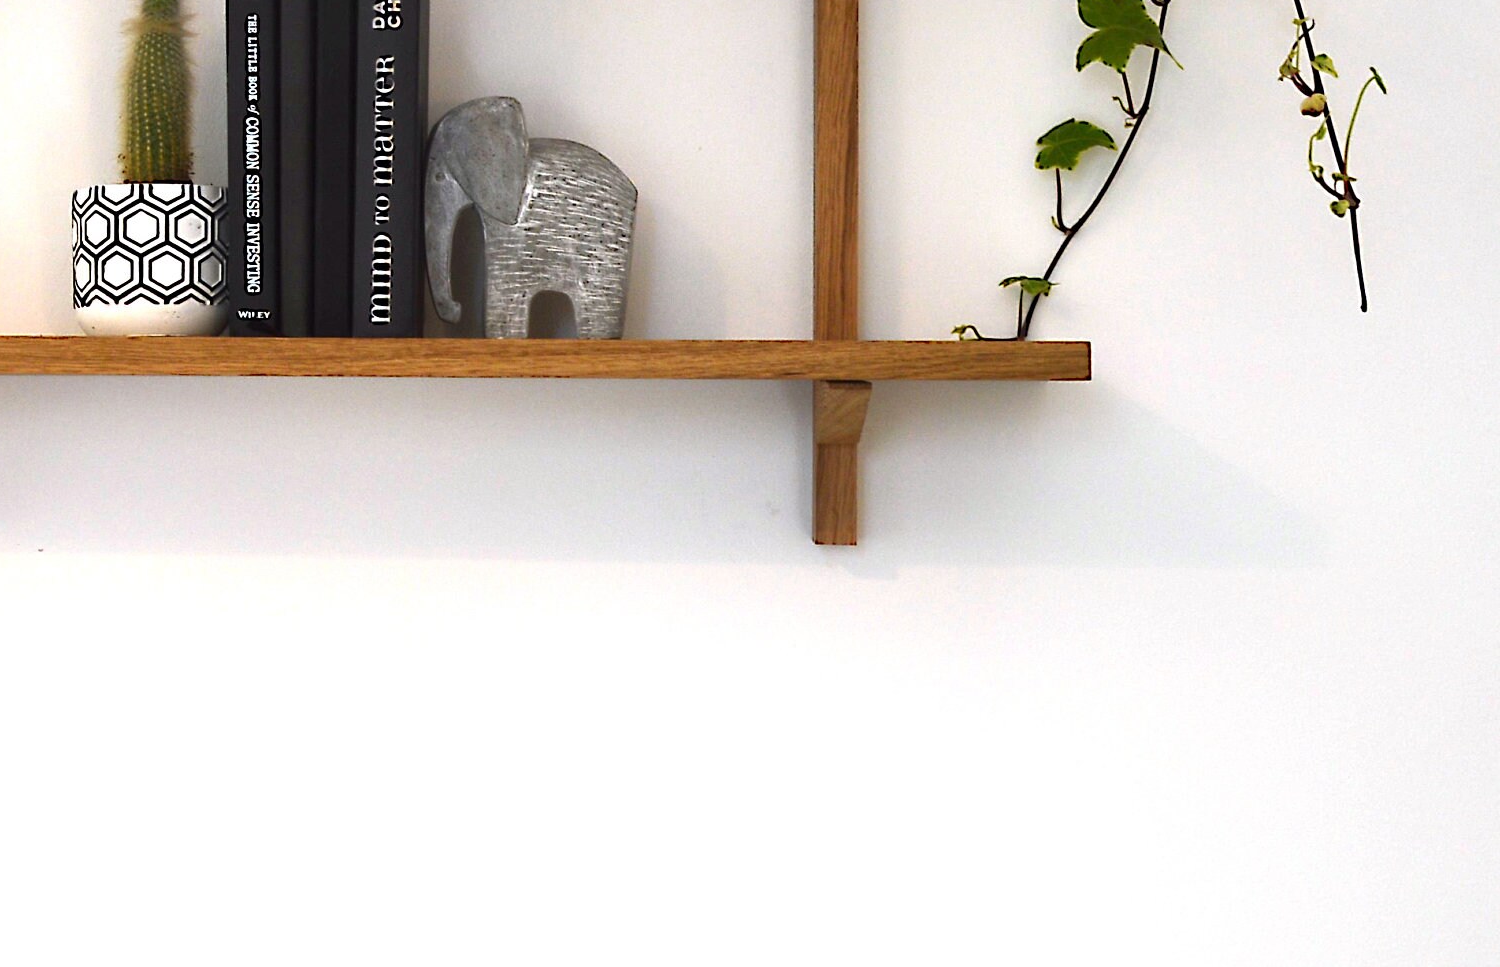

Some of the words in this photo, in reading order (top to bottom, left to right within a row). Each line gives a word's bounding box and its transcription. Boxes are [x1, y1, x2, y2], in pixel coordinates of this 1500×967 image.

[247, 14, 258, 34] THE
[247, 37, 258, 73] LITTLE
[248, 76, 258, 101] BOOK
[247, 105, 260, 115] of
[245, 117, 260, 170] COMMON
[246, 174, 260, 218] SENSE
[246, 223, 261, 293] INVESTING
[237, 311, 271, 319] WILEY
